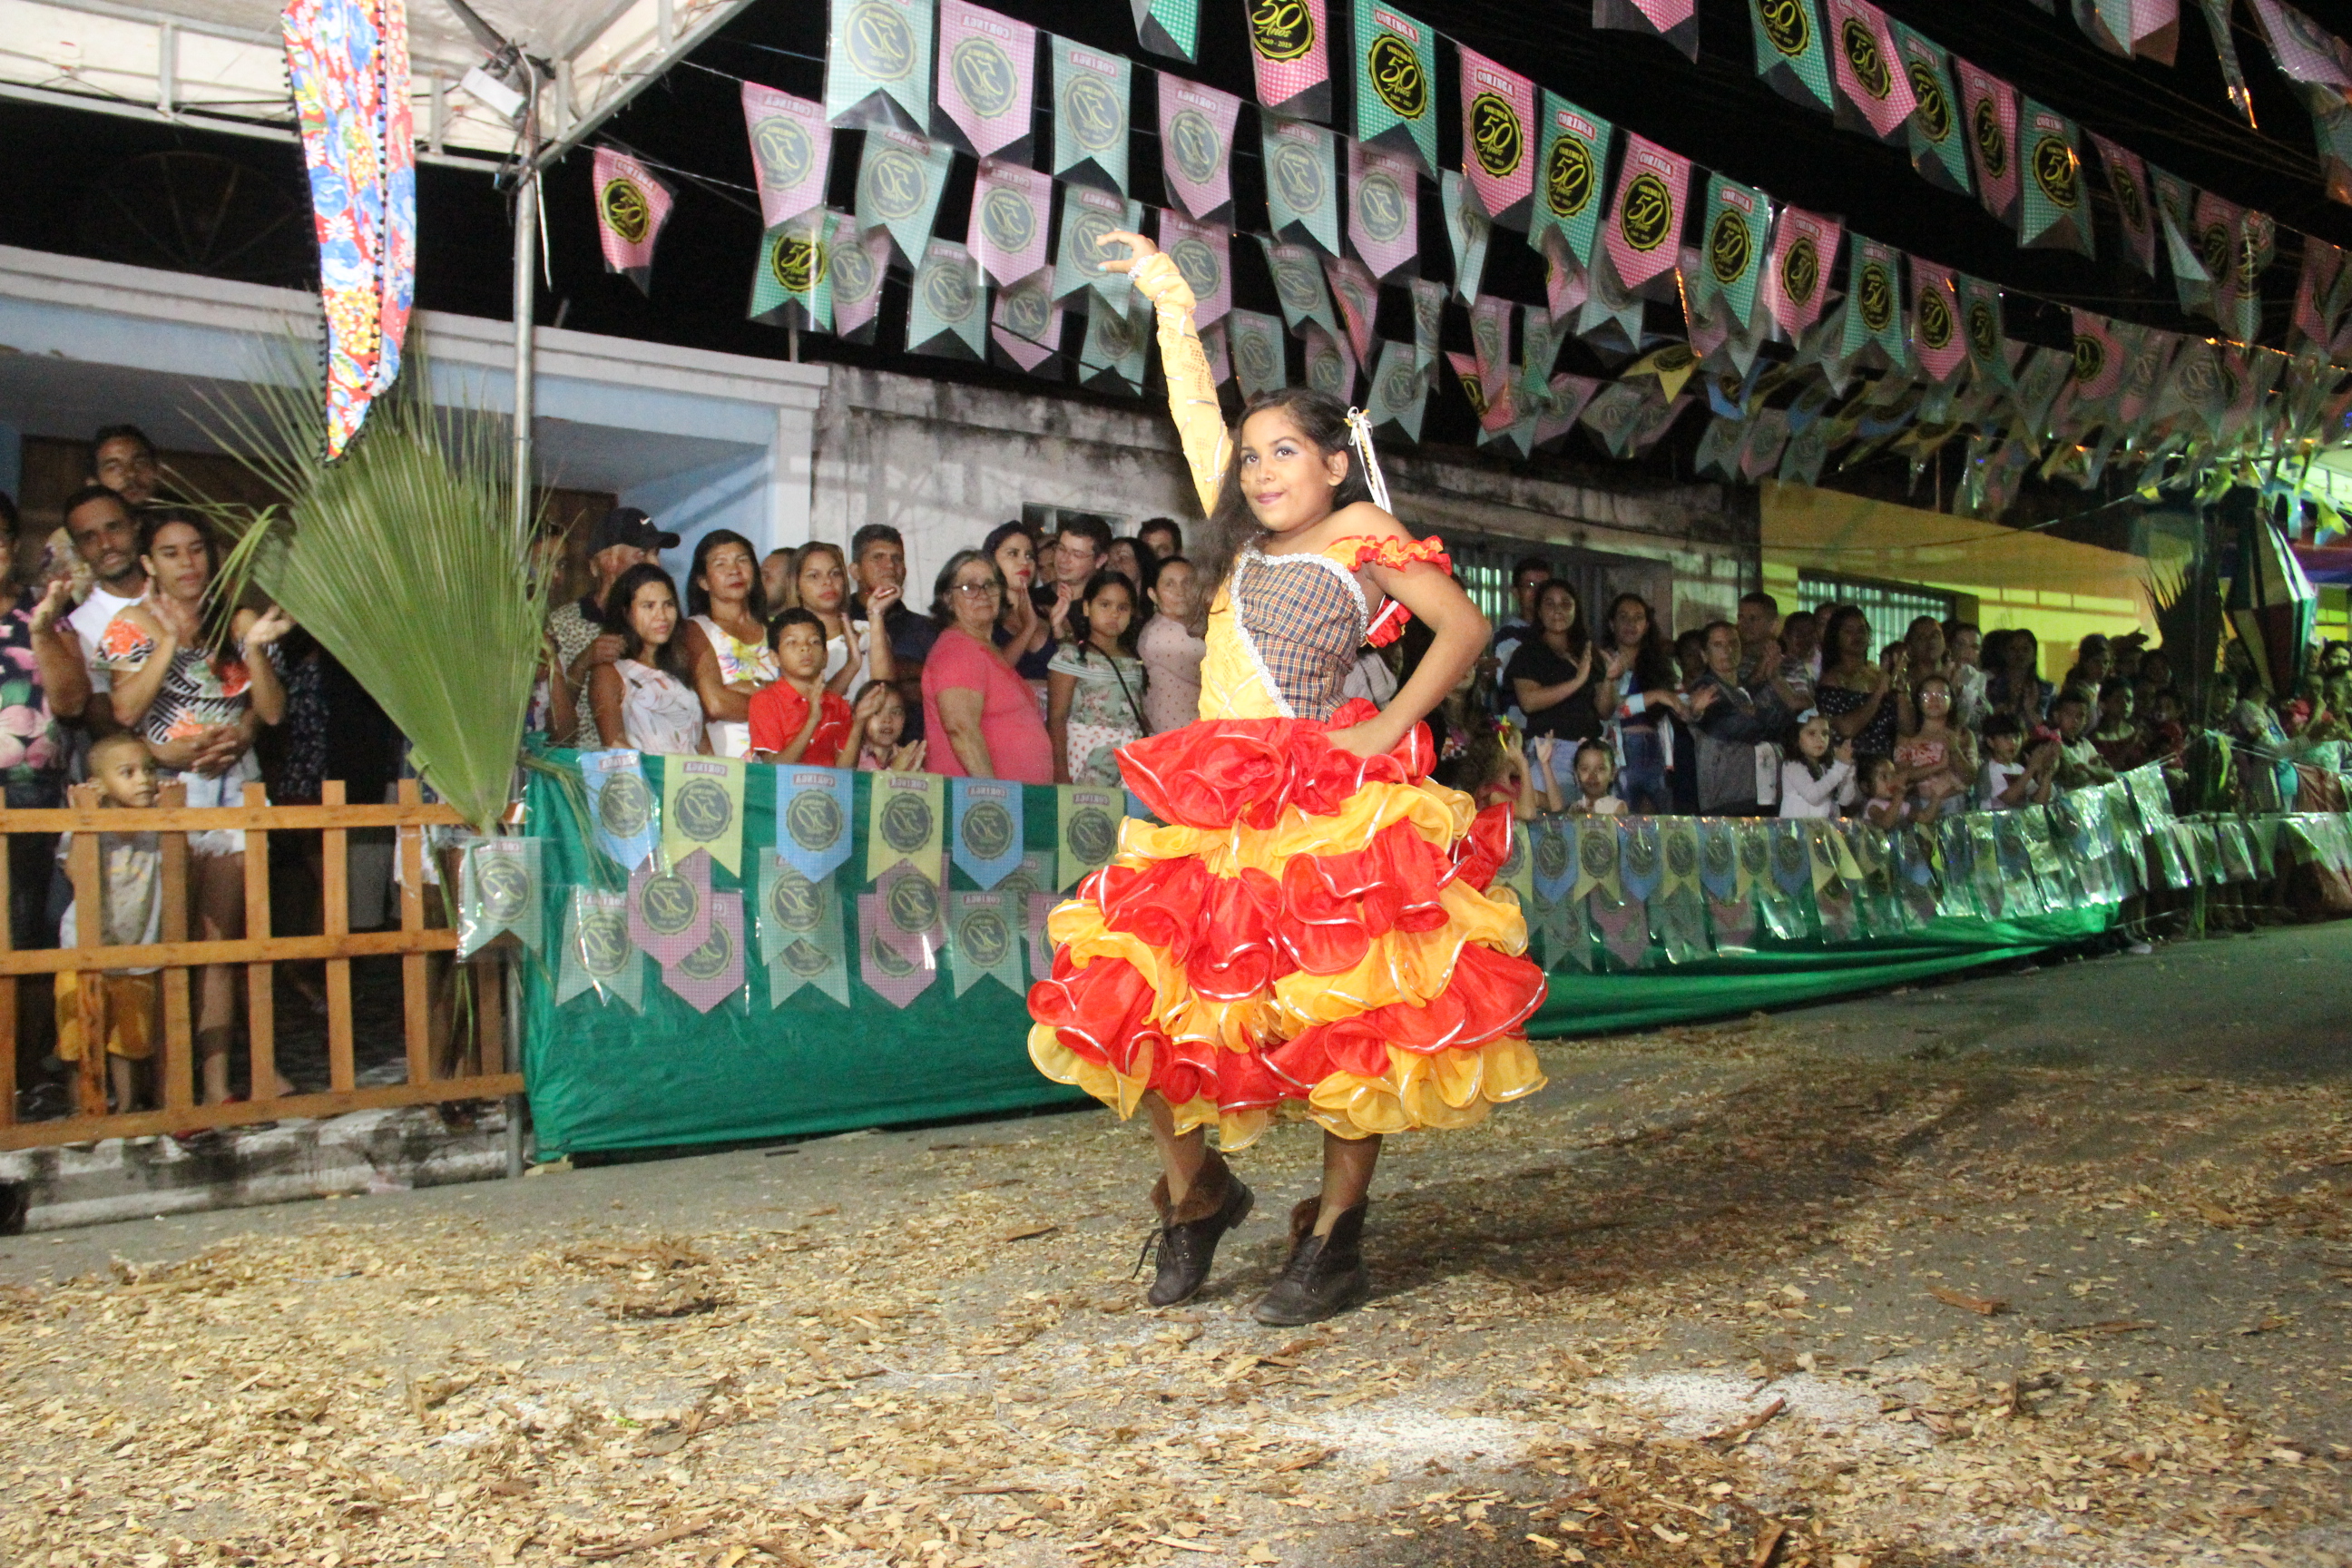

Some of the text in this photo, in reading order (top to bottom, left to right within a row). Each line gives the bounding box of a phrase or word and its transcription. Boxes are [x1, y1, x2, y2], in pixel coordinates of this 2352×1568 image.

[1252, 0, 1303, 30] 50
[1377, 10, 1416, 40] CORINGA
[1255, 20, 1292, 38] Anos
[1387, 44, 1413, 63] CORINGA
[1852, 39, 1876, 72] 50
[1380, 56, 1417, 90] 50
[1477, 71, 1514, 96] CORINGA
[1384, 80, 1411, 97] Anos
[1918, 83, 1940, 114] 50
[1484, 104, 1509, 122] CORINGA
[1558, 113, 1594, 138] CORINGA
[1477, 115, 1513, 149] 50
[1559, 146, 1584, 162] CORINGA
[1639, 152, 1671, 176] CORINGA
[1550, 157, 1586, 190] 50
[2044, 155, 2073, 182] 50
[1627, 194, 1663, 225] 50
[1722, 190, 1750, 211] CORINGA
[780, 245, 818, 268] 50
[1715, 230, 1743, 258] 50
[1863, 282, 1886, 306] 50
